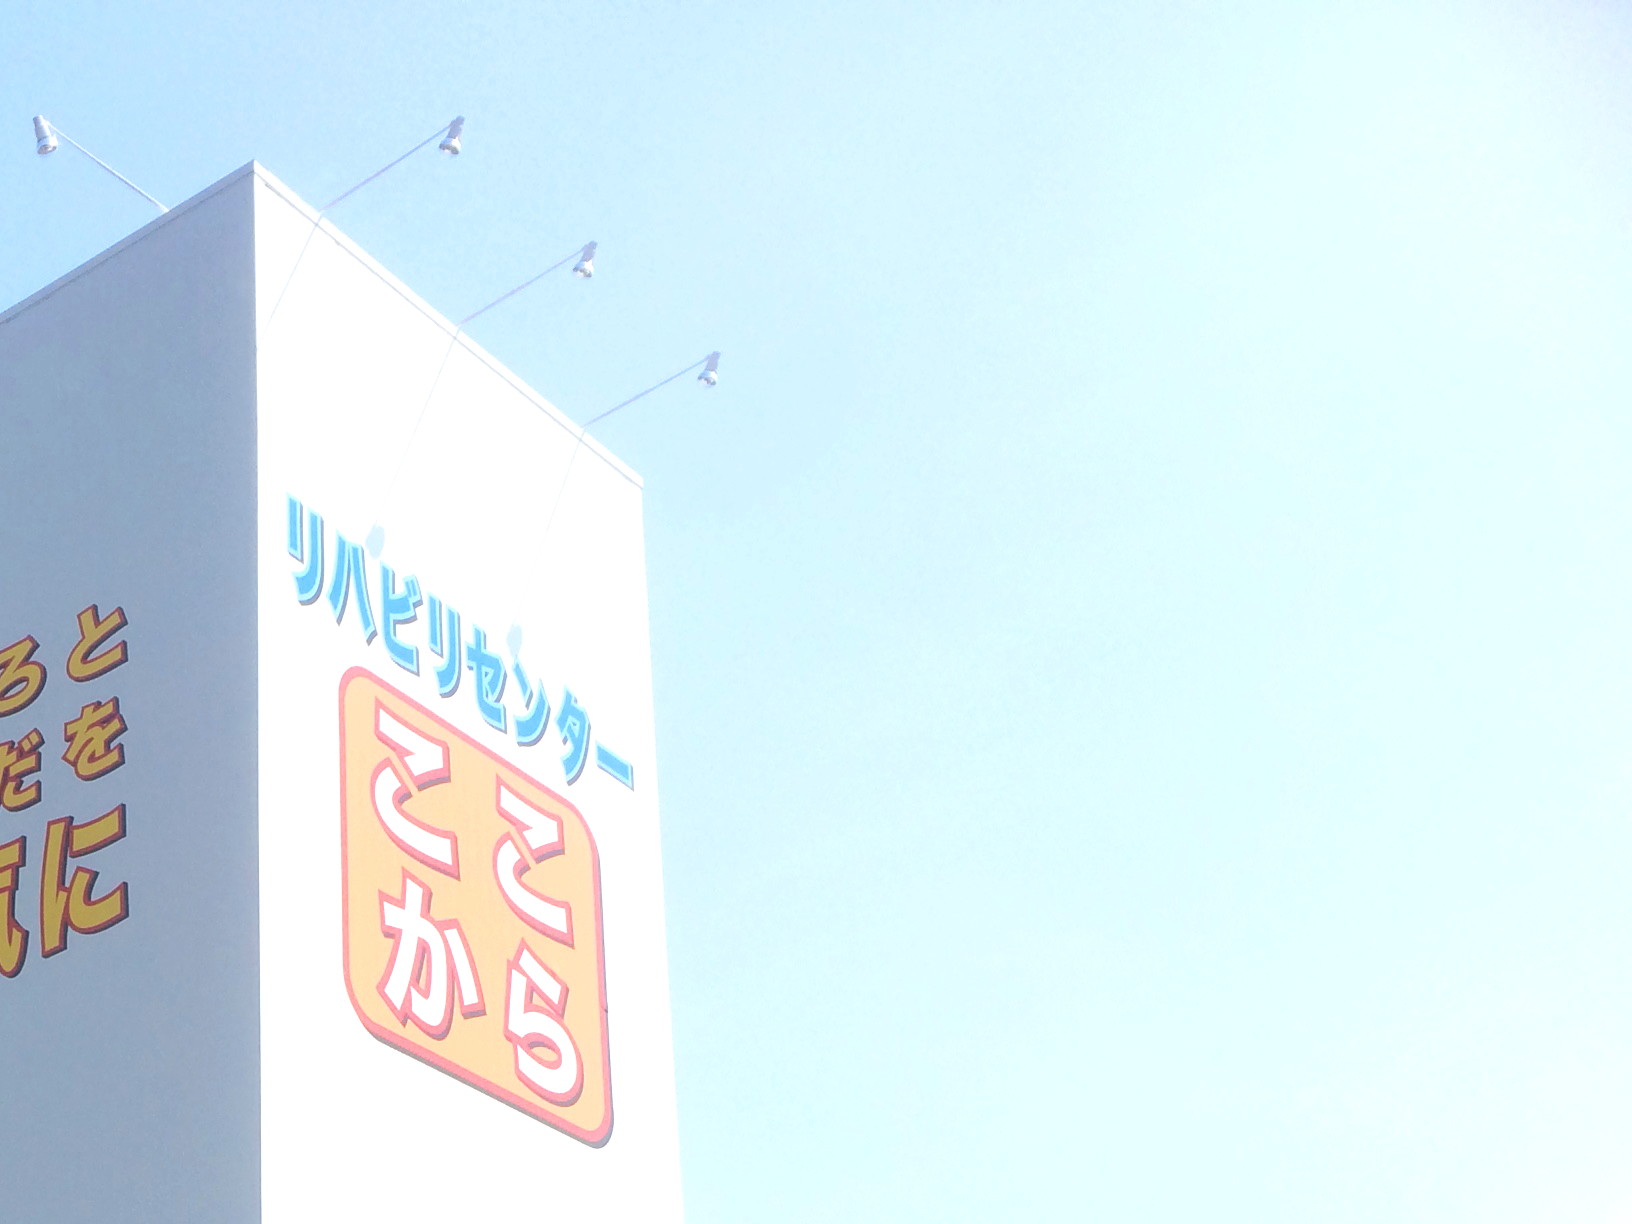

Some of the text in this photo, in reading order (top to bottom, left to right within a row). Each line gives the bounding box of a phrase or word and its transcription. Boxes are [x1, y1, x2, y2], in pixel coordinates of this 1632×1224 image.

[287, 492, 634, 790] リハビリセンター
[370, 697, 575, 950] ここ
[376, 866, 586, 1107] から
